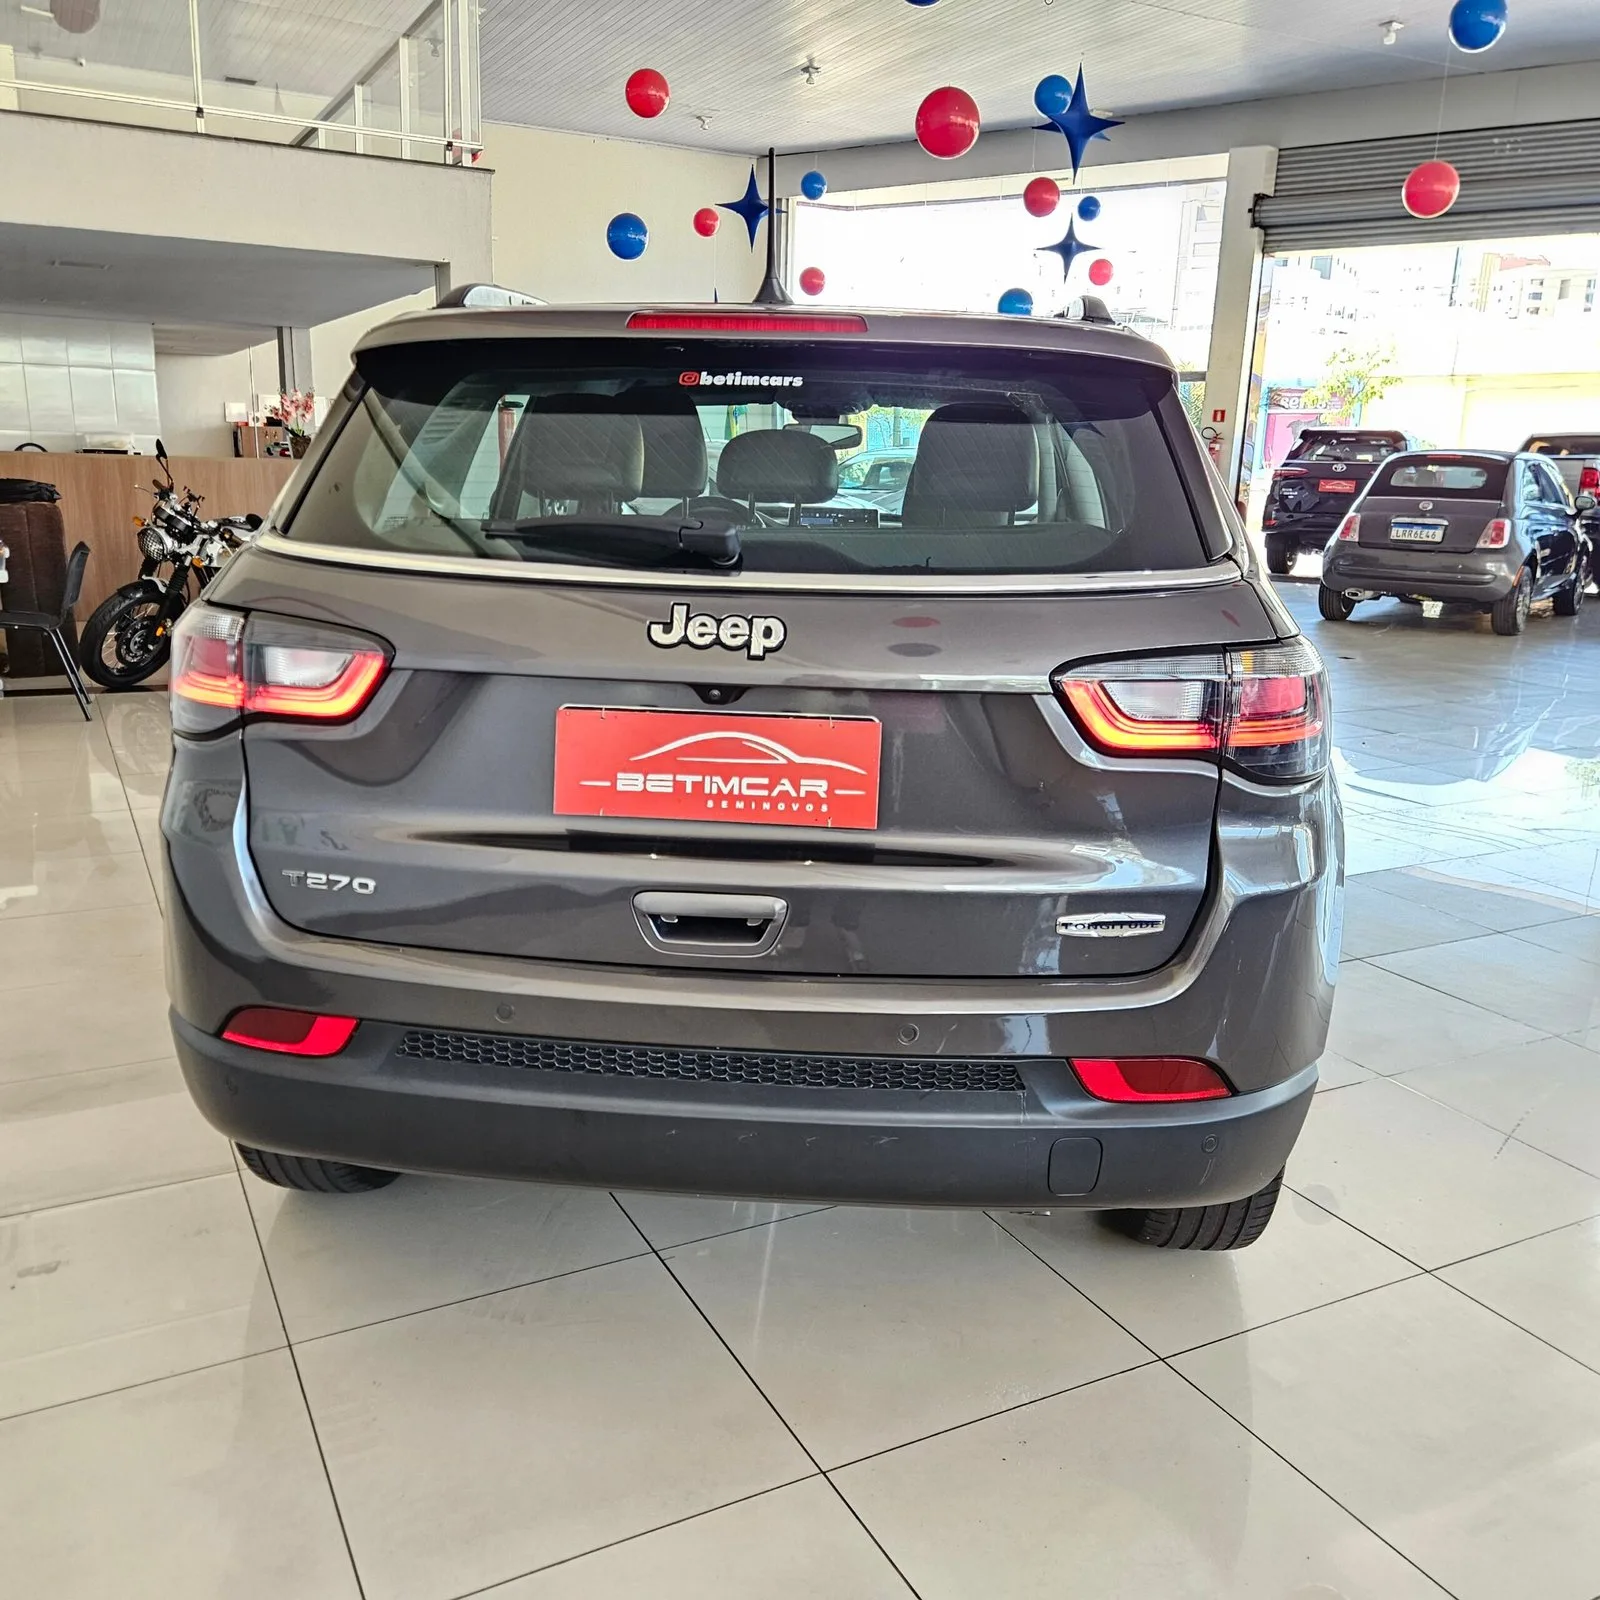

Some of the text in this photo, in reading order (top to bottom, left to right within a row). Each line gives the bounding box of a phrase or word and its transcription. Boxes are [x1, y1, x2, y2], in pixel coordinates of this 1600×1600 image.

[699, 371, 804, 387] betimcars
[647, 602, 787, 660] Jeep
[616, 772, 829, 798] BETIMCAR
[706, 799, 829, 813] SEMINOVOS
[281, 869, 377, 895] T270
